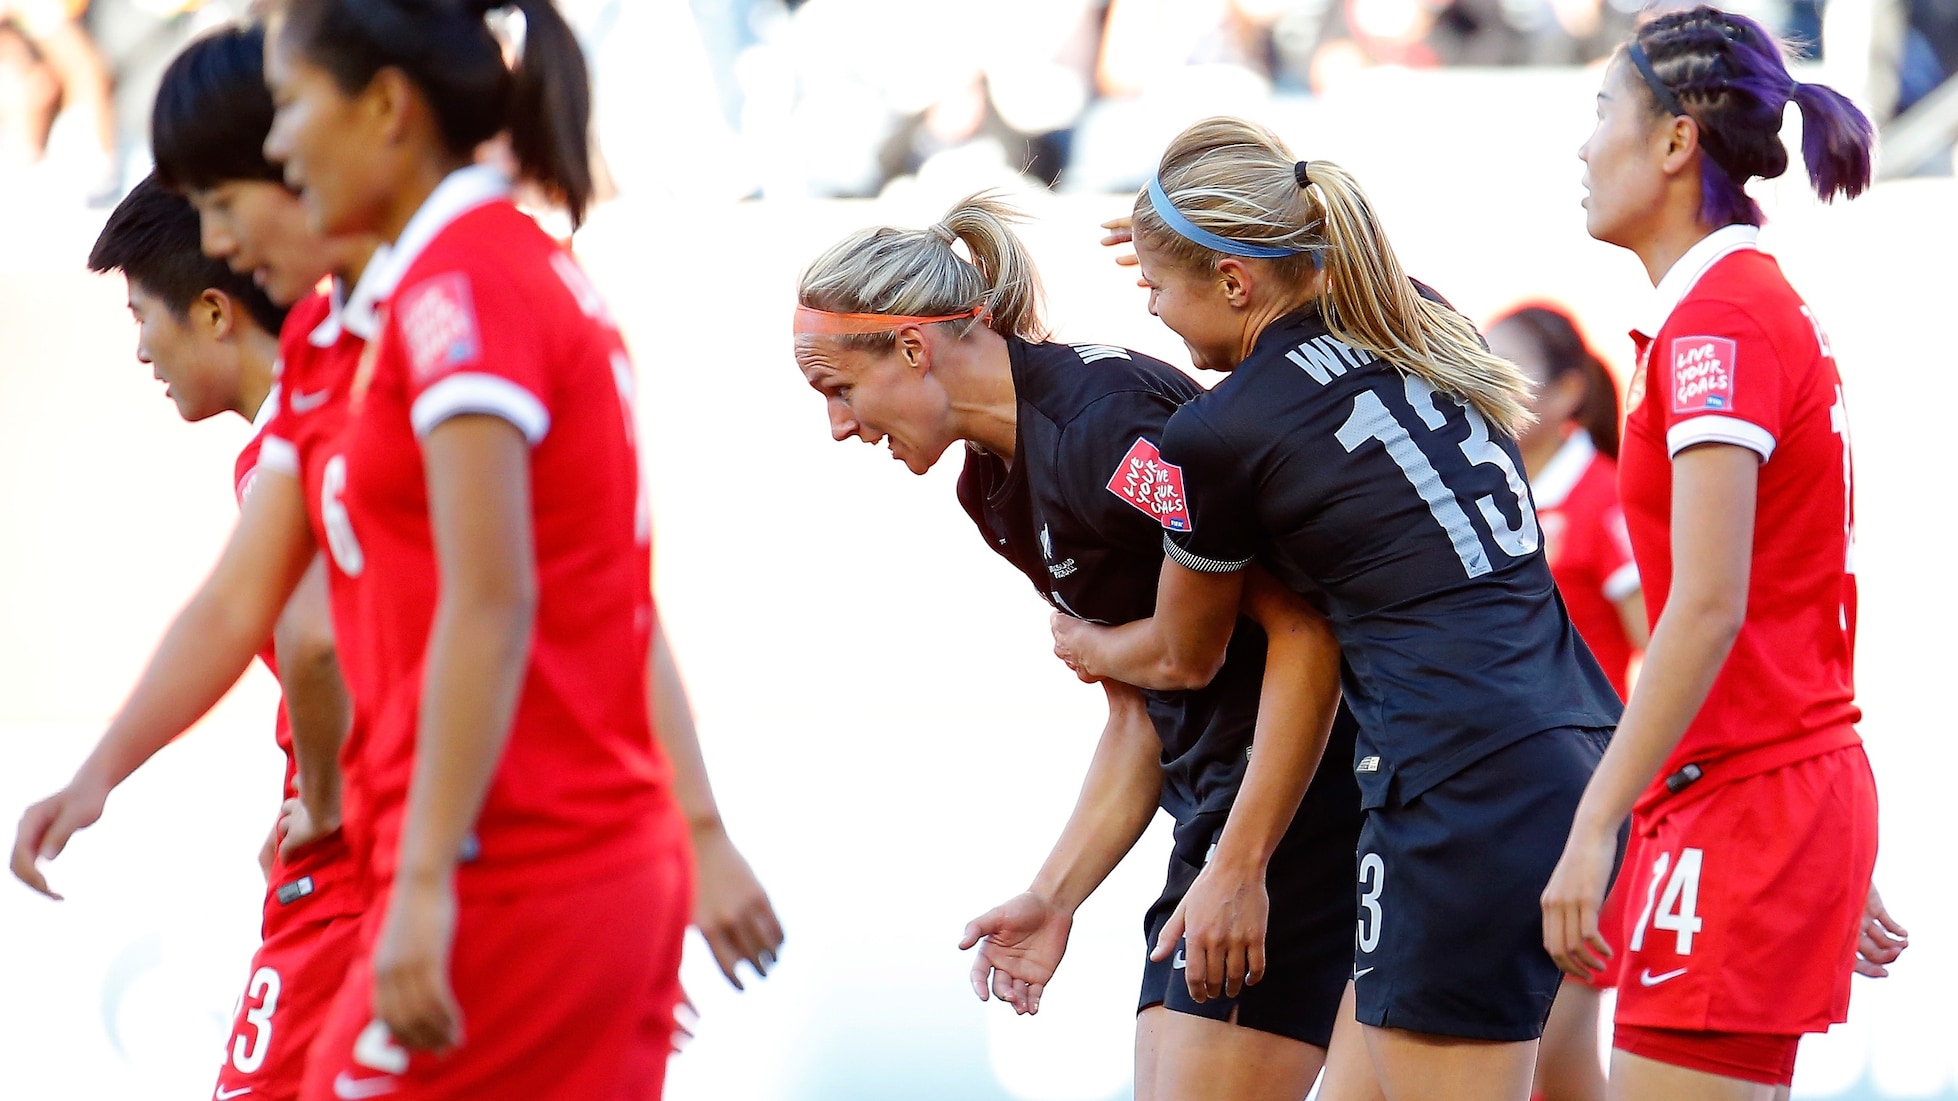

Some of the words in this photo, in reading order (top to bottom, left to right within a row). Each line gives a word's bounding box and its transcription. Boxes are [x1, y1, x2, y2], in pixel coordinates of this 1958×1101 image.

[1676, 359, 1726, 386] YOUR
[1677, 343, 1715, 368] LIVE
[1677, 374, 1729, 404] GOALS
[1122, 457, 1144, 497] LIVE
[1135, 459, 1159, 504] YOUR
[1334, 373, 1540, 579] 13
[1356, 852, 1384, 953] 3
[1629, 847, 1703, 955] 14
[226, 966, 282, 1074] 3
